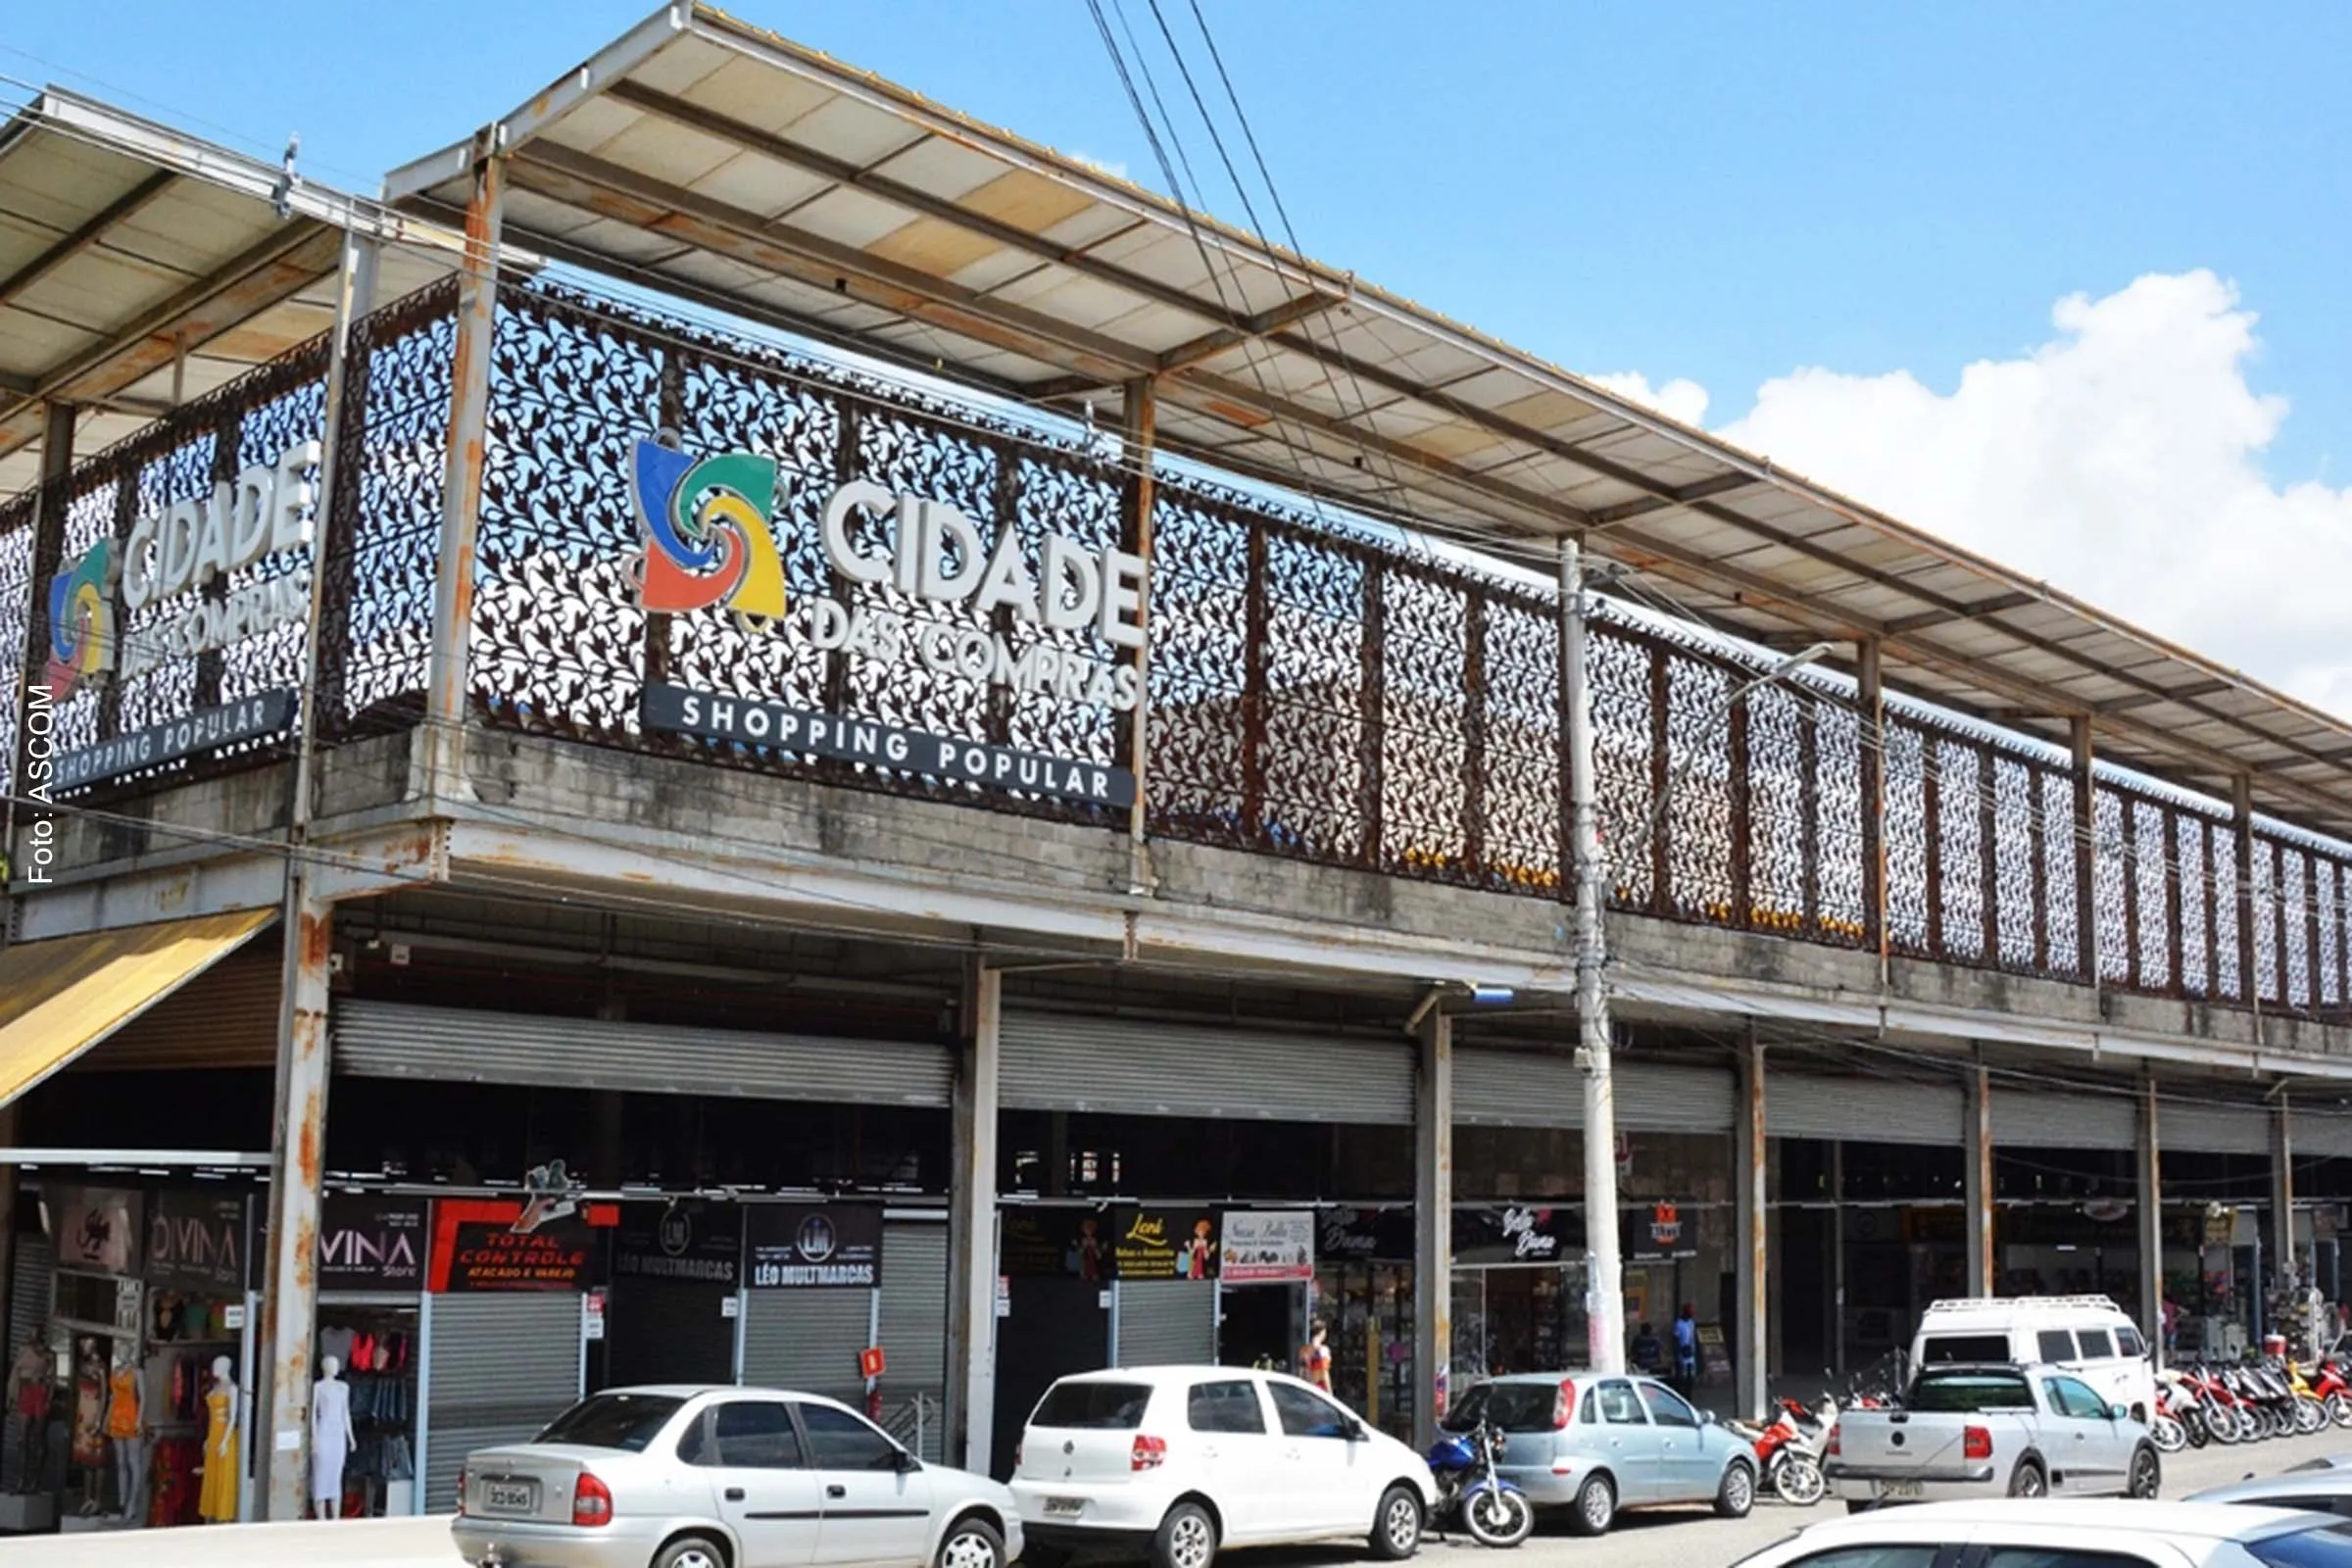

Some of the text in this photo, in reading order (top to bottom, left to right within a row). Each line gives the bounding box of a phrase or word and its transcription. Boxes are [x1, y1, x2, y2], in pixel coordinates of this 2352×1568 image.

[122, 440, 321, 612] CIDADE
[821, 479, 1148, 648] CIDADE
[810, 596, 1140, 712] DAS COMPRAS
[55, 699, 266, 785] SHOPPING POPULAR
[682, 695, 1109, 799] SHOPPING POPULAR
[319, 1228, 416, 1266] VINA
[486, 1232, 560, 1248] TOTAL
[755, 1261, 780, 1286] LÉO
